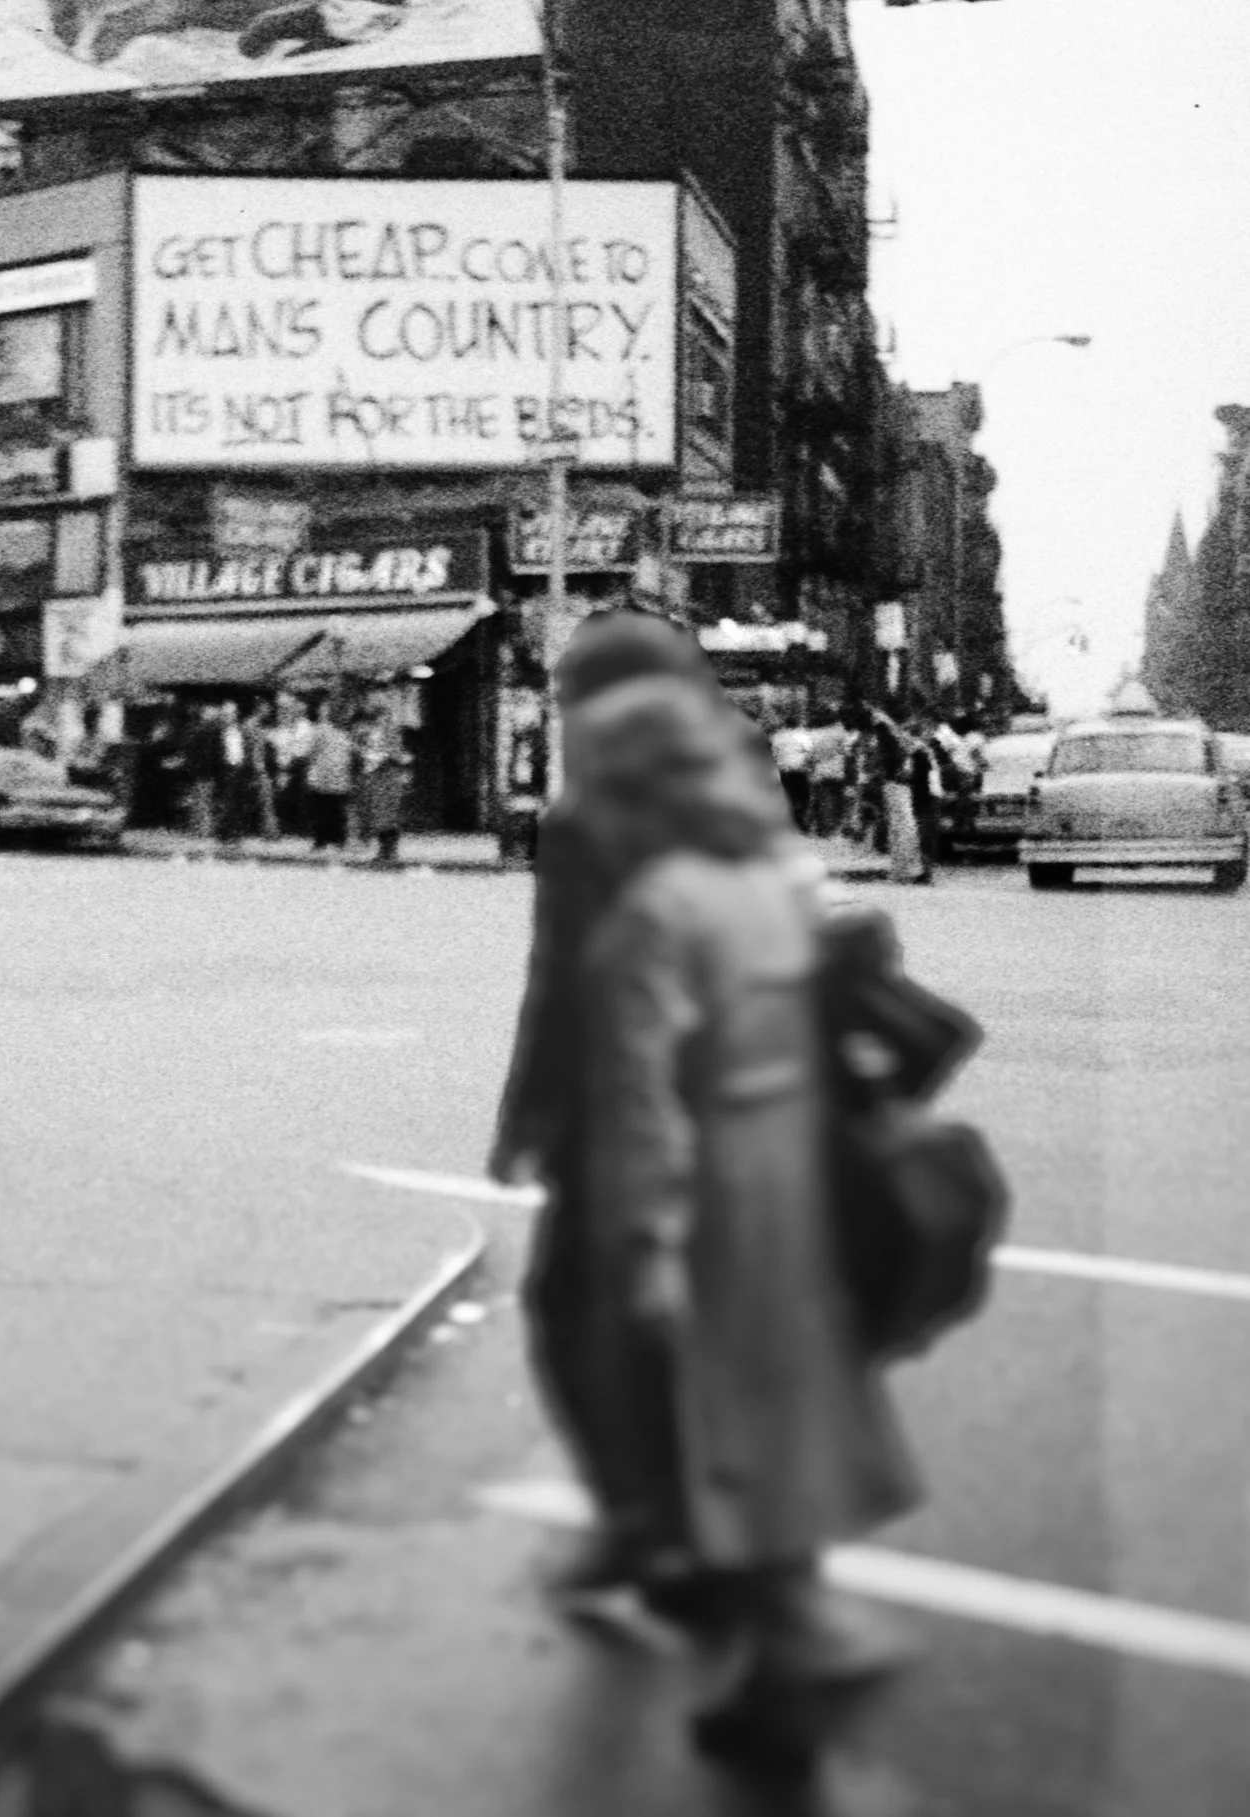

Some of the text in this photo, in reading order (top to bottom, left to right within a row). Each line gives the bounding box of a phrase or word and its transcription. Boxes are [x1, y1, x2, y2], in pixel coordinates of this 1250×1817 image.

[151, 235, 245, 280] GET
[602, 238, 648, 284] TO
[356, 299, 652, 360] COUNTRY.
[222, 390, 313, 440] NOT
[324, 389, 417, 440] FOR
[424, 390, 502, 440] THE
[140, 545, 451, 598] VILLAGE CIGARS
